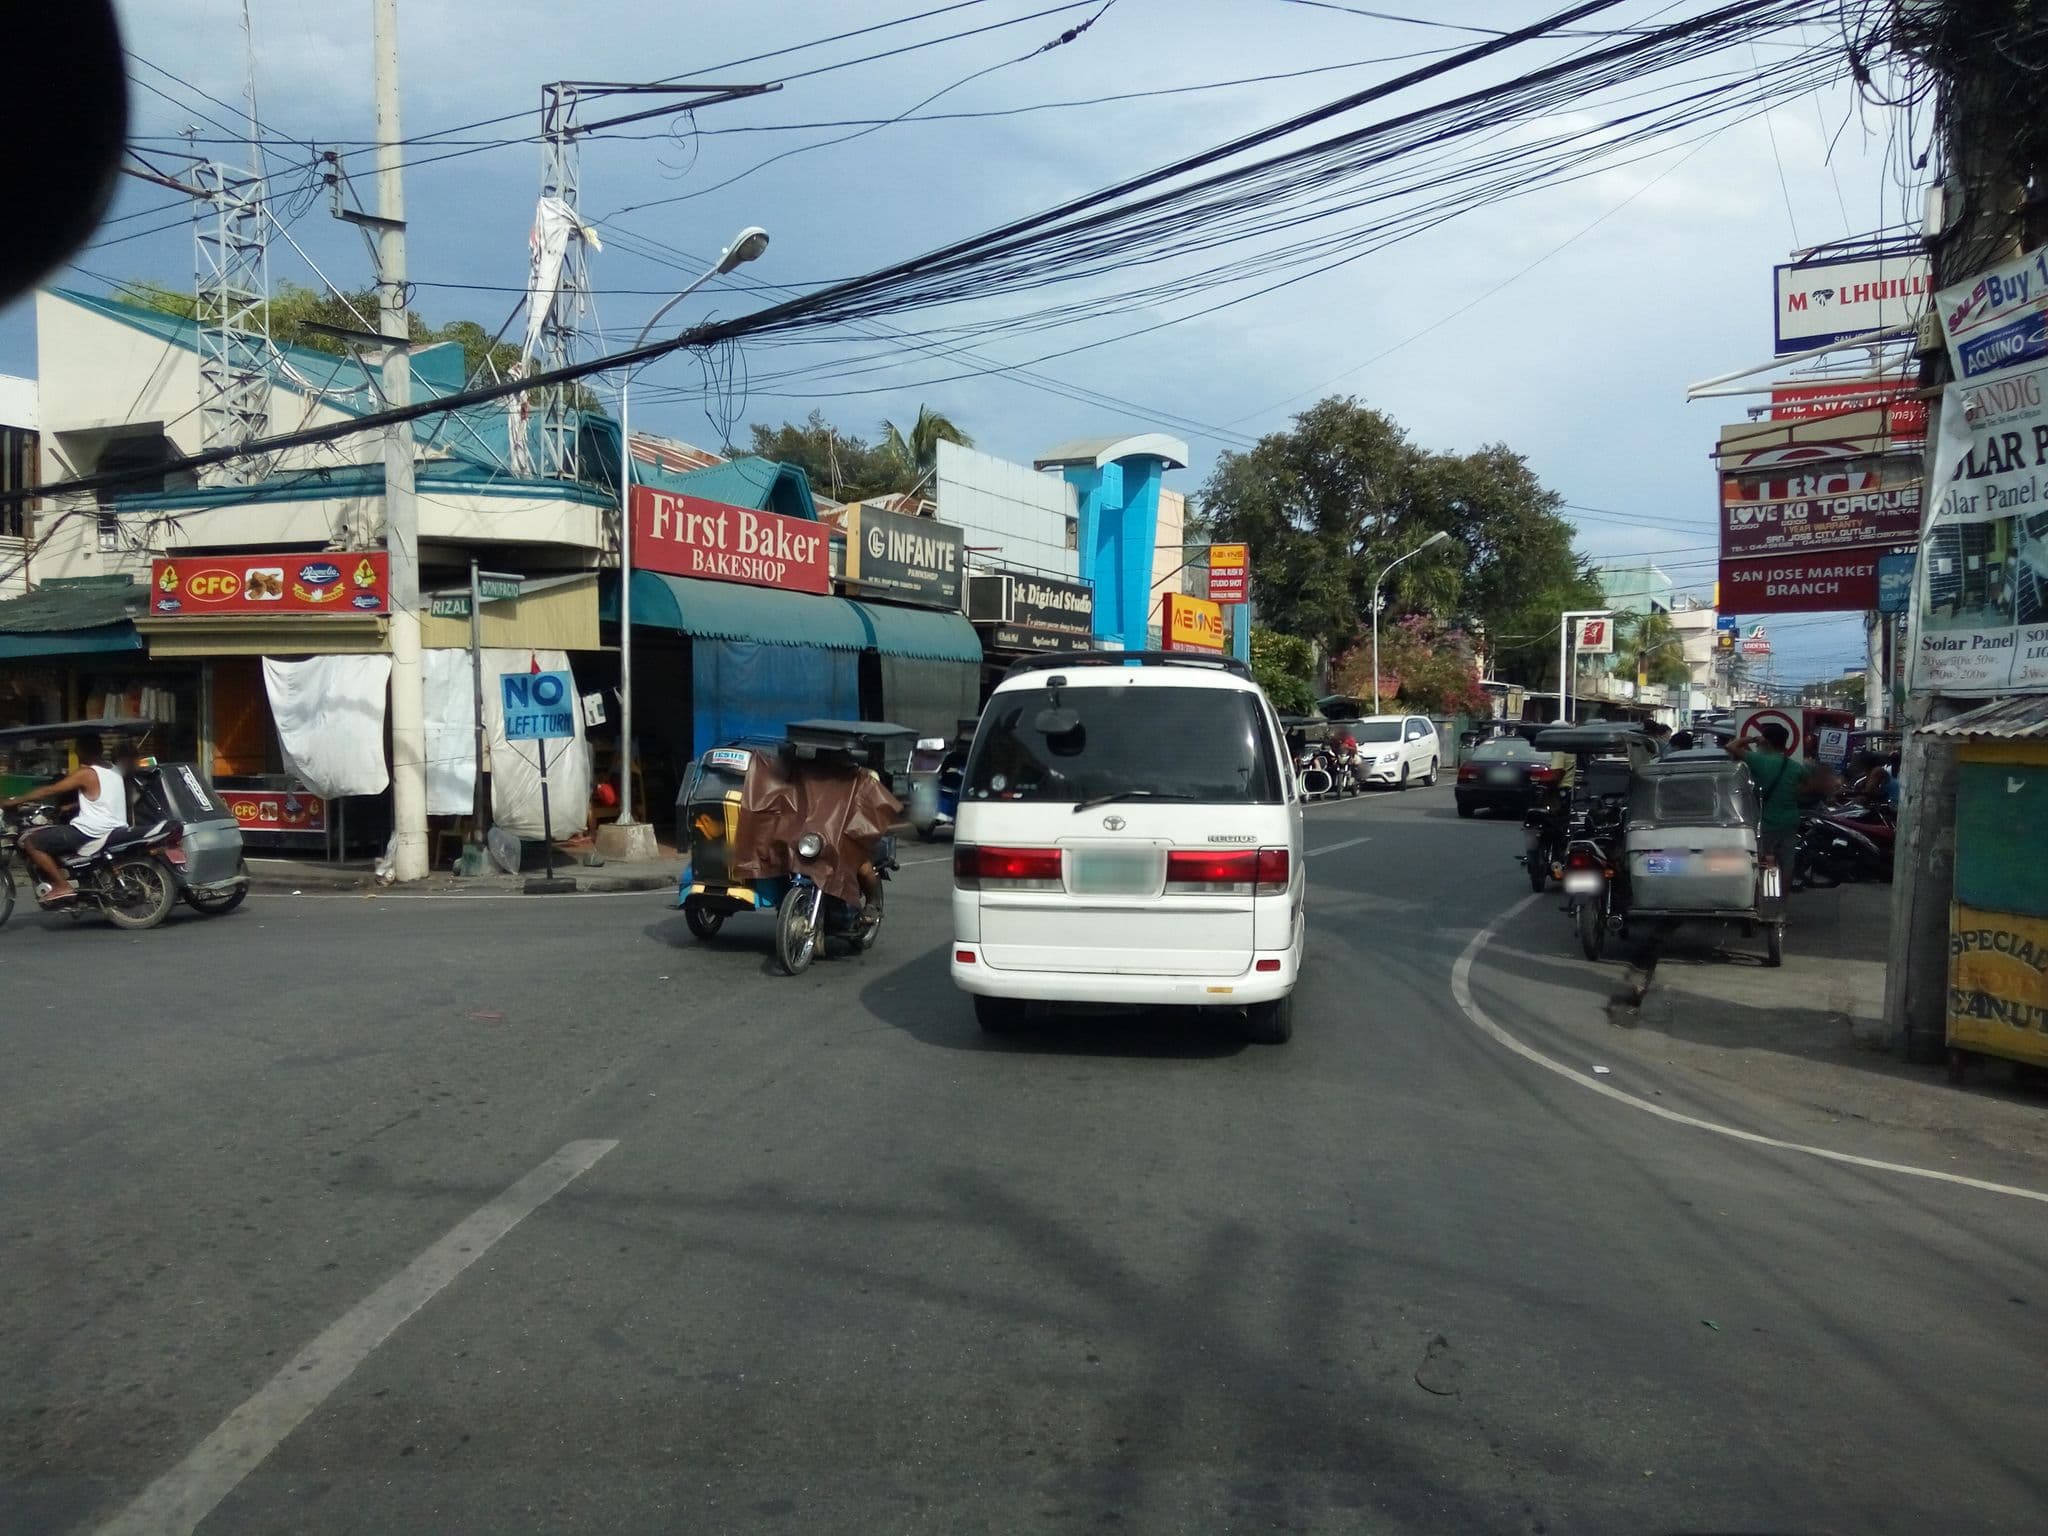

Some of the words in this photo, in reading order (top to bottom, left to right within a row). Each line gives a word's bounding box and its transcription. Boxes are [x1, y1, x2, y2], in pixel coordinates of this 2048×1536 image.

[1986, 271, 2029, 308] Buy
[1788, 292, 1808, 313] M
[1967, 334, 2025, 375] AQUINO
[1817, 488, 1920, 516] TORQUE
[1985, 475, 2036, 512] Panel
[649, 493, 729, 550] First
[736, 510, 821, 565] Baker
[1787, 533, 1812, 542] JOSE
[1815, 530, 1837, 539] CITY
[1840, 526, 1877, 536] OUTLET
[1788, 525, 1811, 534] YEAR
[1813, 519, 1864, 531] WARRANTY
[888, 529, 955, 573] INFANTE
[692, 548, 786, 583] BAKESHOP
[1732, 570, 1763, 583] SAN
[1766, 568, 1803, 582] JOSE
[1808, 564, 1875, 578] MARKET
[191, 576, 237, 595] CFC
[481, 580, 519, 597] BONIFACIO
[1766, 582, 1839, 597] BRANCH
[432, 600, 468, 614] RIZAL
[1027, 583, 1064, 609] Digital
[1064, 591, 1092, 614] Studio
[1921, 635, 1968, 651] Solar
[1971, 632, 2014, 650] Panel
[504, 675, 564, 709] NO
[507, 714, 538, 736] LEFT
[540, 713, 572, 734] TURN
[234, 805, 256, 817] CFC
